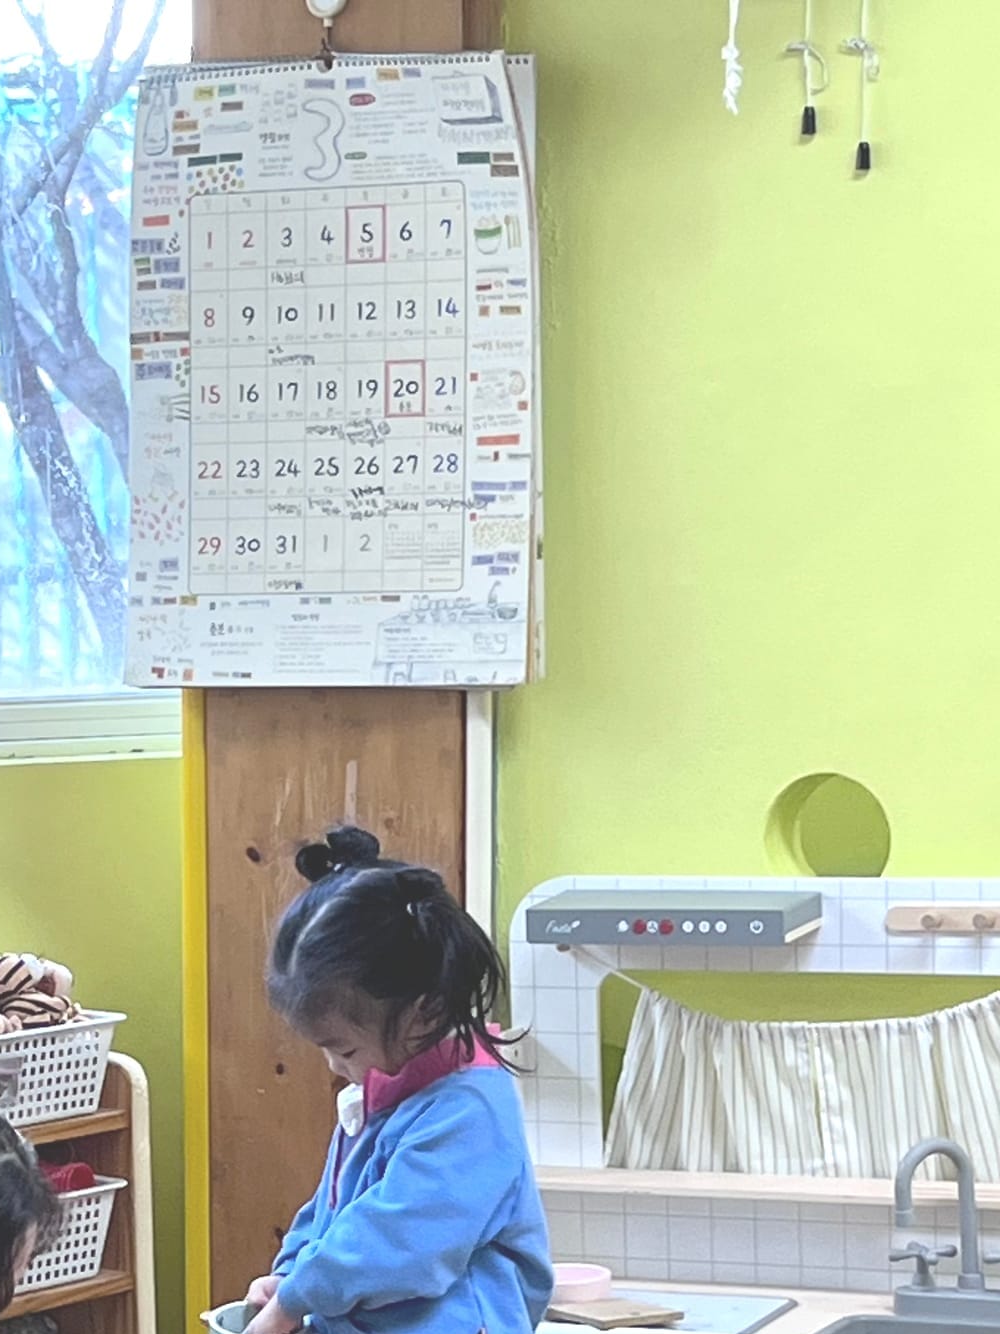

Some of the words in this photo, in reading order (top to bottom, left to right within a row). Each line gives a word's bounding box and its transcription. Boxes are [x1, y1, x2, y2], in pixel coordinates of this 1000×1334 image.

[242, 229, 254, 249] 2
[281, 227, 292, 247] 3
[320, 225, 334, 245] 4
[360, 223, 374, 243] 5
[399, 221, 413, 242] 6
[439, 219, 452, 240] 7
[203, 308, 215, 328] 8
[242, 306, 255, 324] 9
[277, 306, 298, 325] 10
[318, 303, 335, 322] 11
[357, 301, 377, 321] 12
[397, 299, 416, 320] 13
[437, 297, 459, 317] 14
[201, 385, 221, 404] 15
[239, 383, 260, 403] 16
[278, 382, 298, 401] 17
[317, 380, 337, 401] 18
[358, 379, 378, 398] 19
[393, 378, 419, 398] 20
[435, 376, 457, 396] 21
[197, 460, 222, 480] 22
[236, 458, 260, 479] 23
[275, 459, 301, 477] 24
[314, 456, 340, 477] 25
[354, 456, 380, 476] 26
[393, 454, 418, 474] 27
[433, 453, 458, 474] 28
[197, 536, 222, 555] 29
[235, 535, 261, 556] 30
[276, 535, 297, 555] 31
[359, 533, 371, 552] 2
